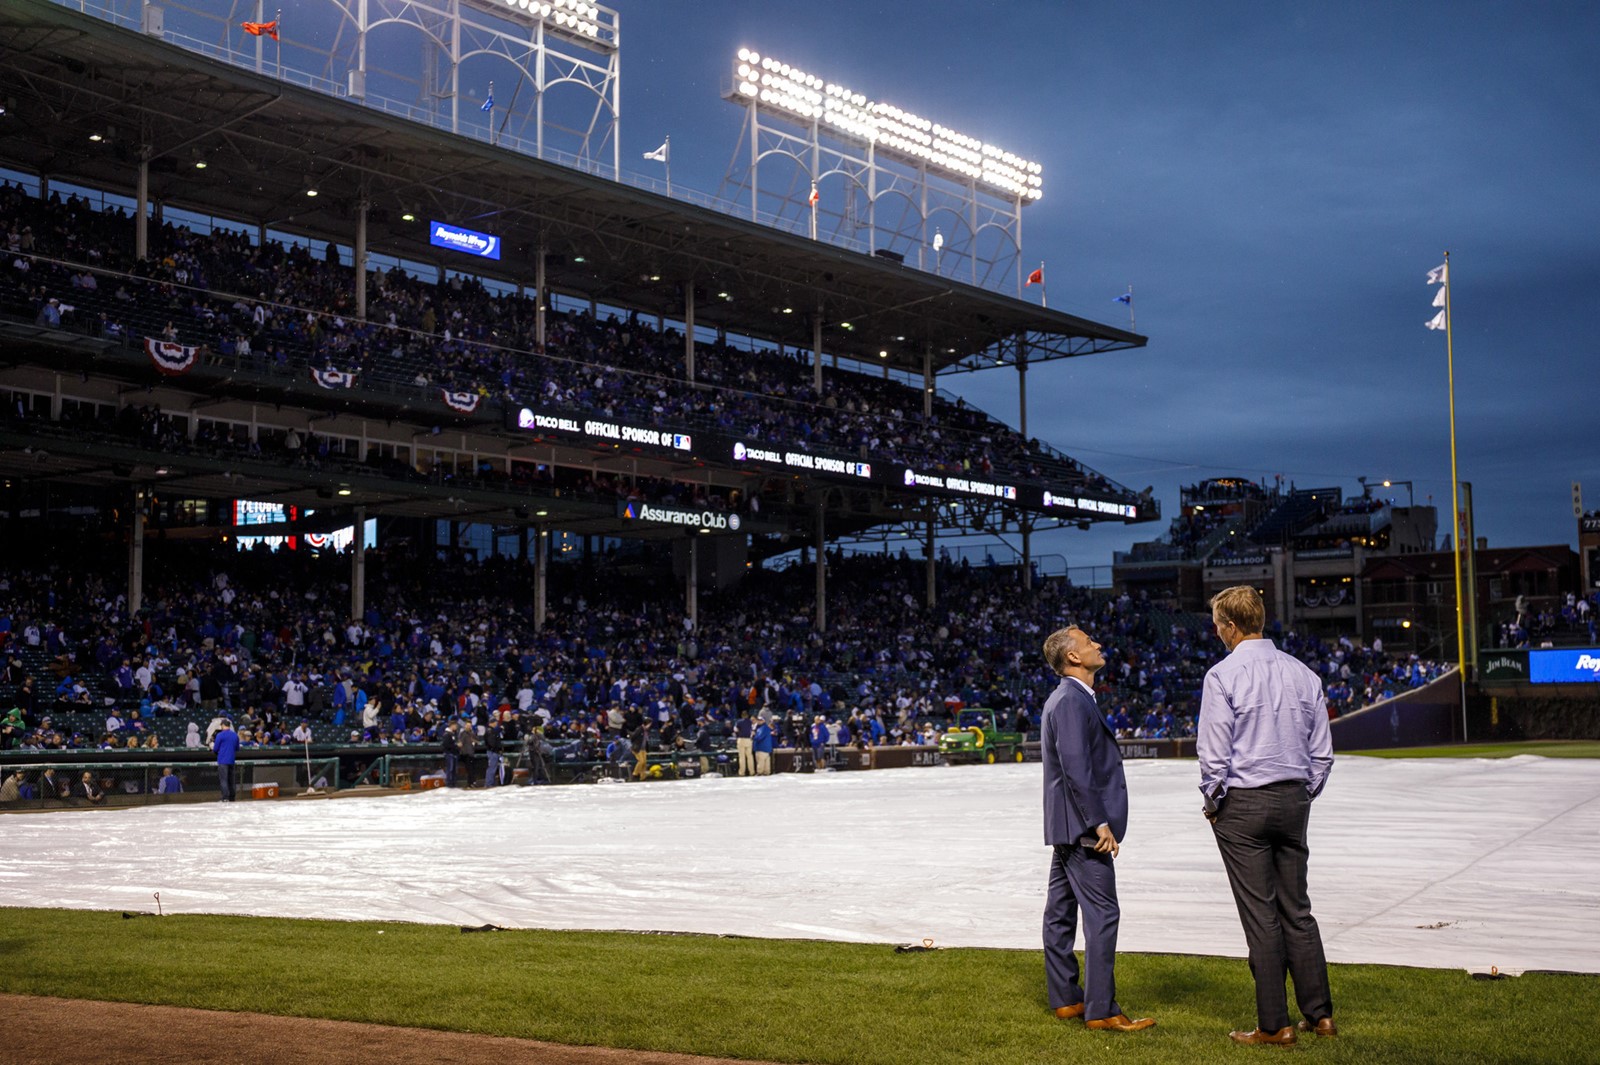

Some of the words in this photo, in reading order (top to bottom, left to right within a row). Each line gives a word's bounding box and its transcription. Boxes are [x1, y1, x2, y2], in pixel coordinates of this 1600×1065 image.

[535, 415, 558, 428] TACO
[559, 418, 580, 432] BELL
[585, 420, 620, 439] OFFICIAL
[622, 426, 659, 445] SPONSOR
[661, 432, 672, 447] OF
[747, 448, 764, 460] TACO
[764, 451, 782, 463] BELL
[785, 452, 813, 469] OFFICIAL
[815, 457, 845, 473] SPONSOR
[846, 461, 855, 474] OF
[915, 474, 930, 485] TACO
[930, 477, 944, 487] BELL
[946, 478, 969, 491] OFFICIAL
[970, 481, 995, 495] SPONSOR
[996, 485, 1003, 497] OF
[640, 504, 701, 526] Assurance
[702, 511, 726, 529] Club
[1486, 660, 1501, 674] JIM
[1501, 656, 1522, 673] BEAM
